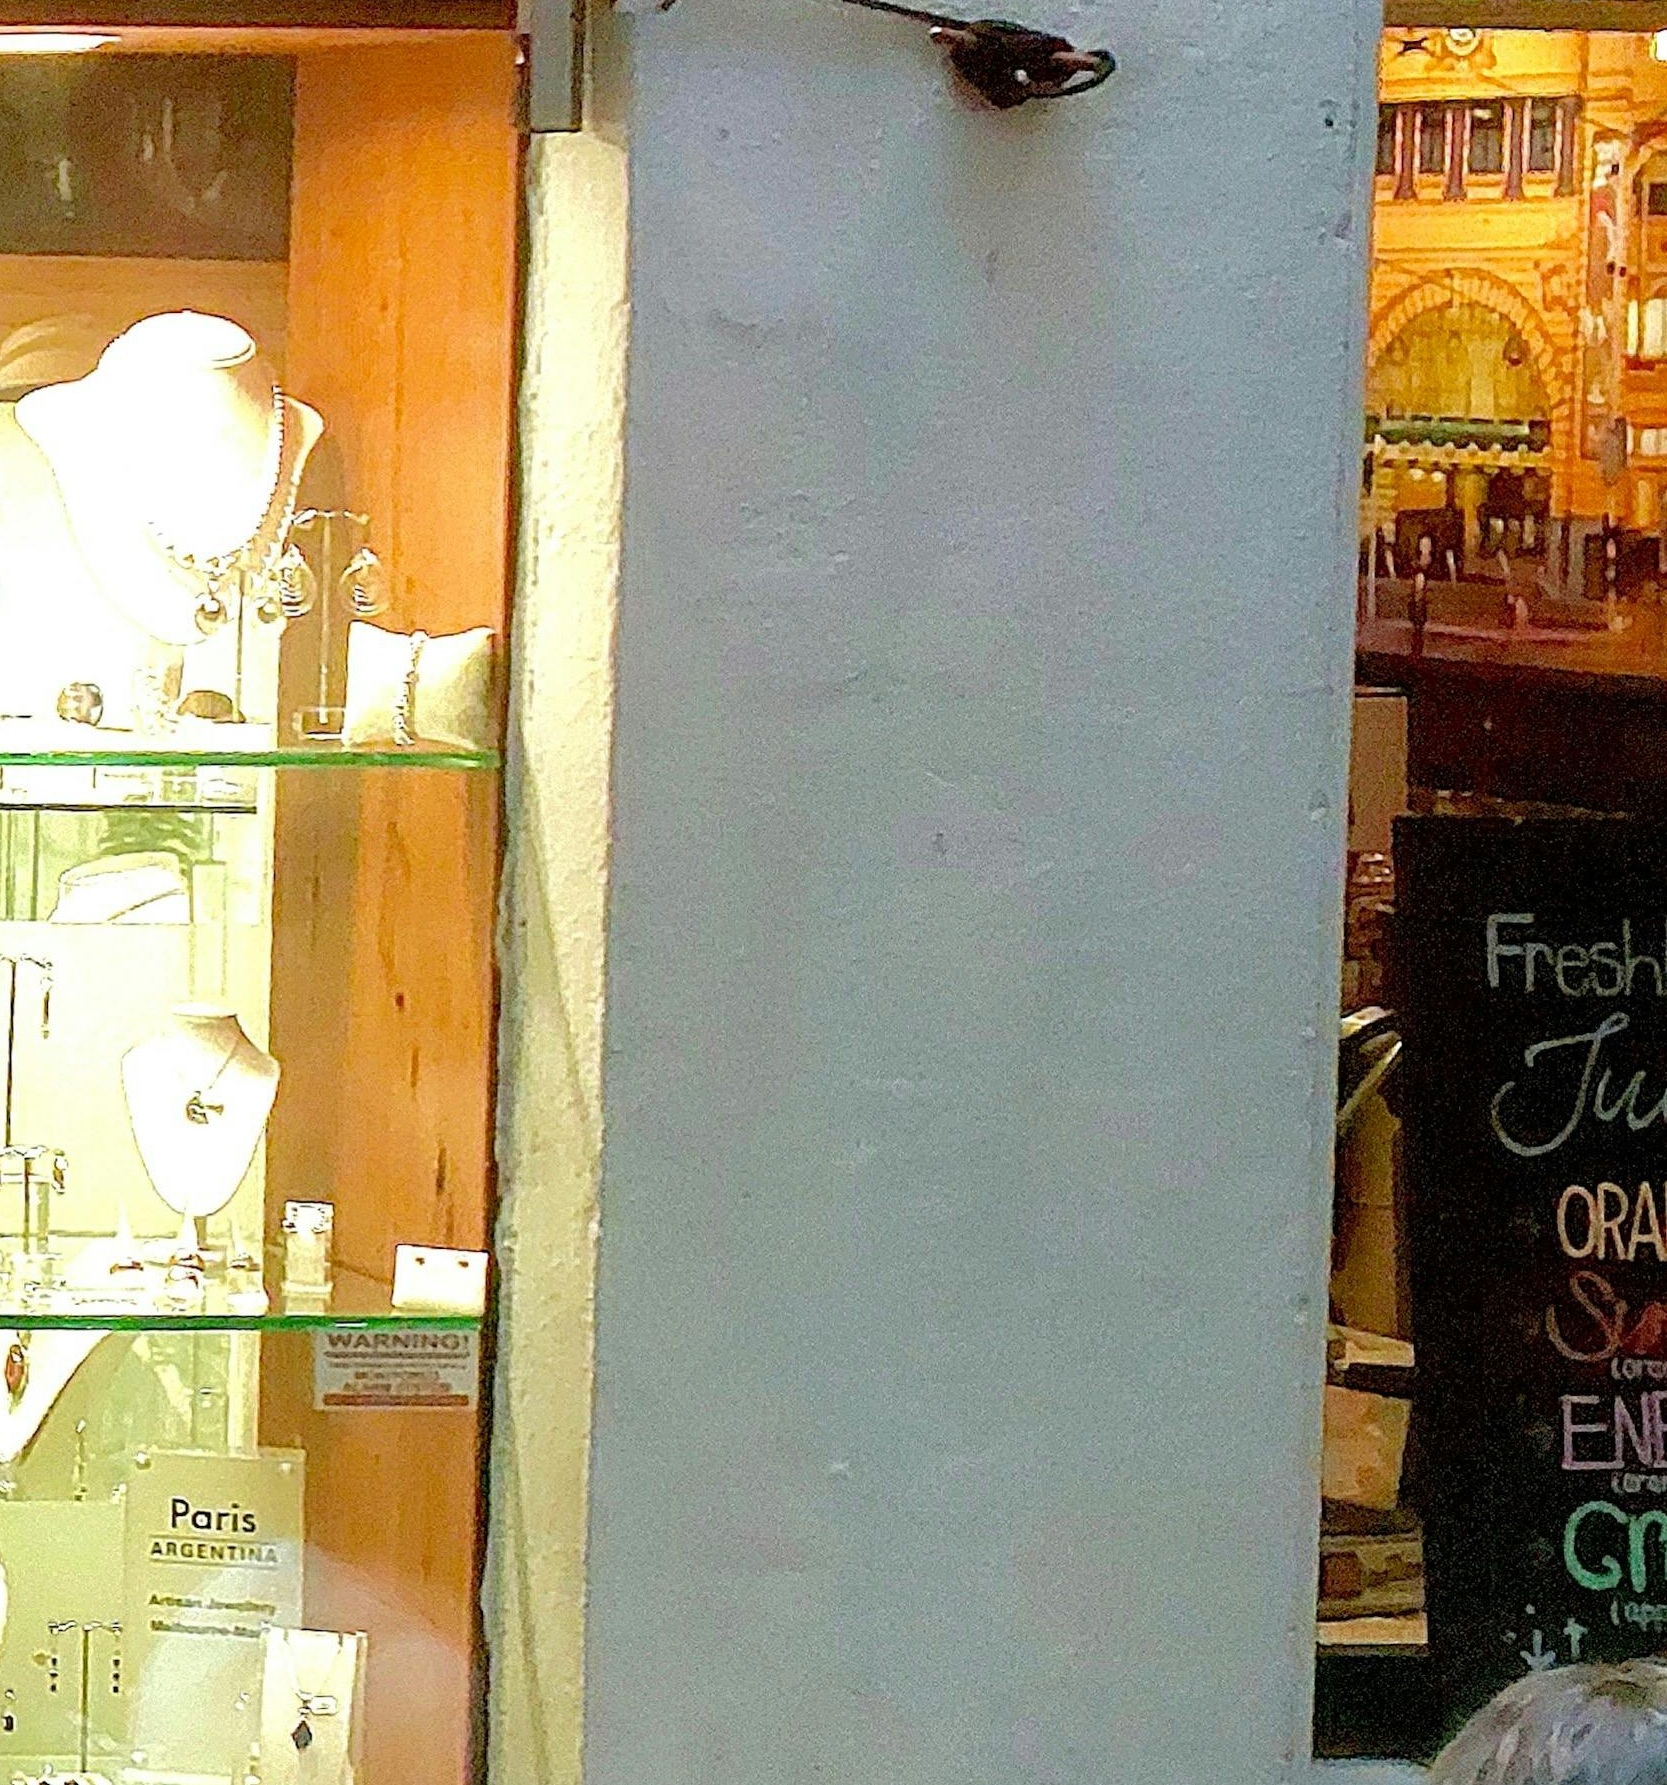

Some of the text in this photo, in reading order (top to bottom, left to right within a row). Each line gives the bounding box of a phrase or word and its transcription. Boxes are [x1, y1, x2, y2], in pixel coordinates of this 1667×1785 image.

[1486, 913, 1667, 997] Fresh
[1490, 1012, 1667, 1157] Ju
[1556, 1181, 1667, 1261] ORA
[151, 1541, 278, 1563] ARGENTINA
[171, 1498, 257, 1533] Paris
